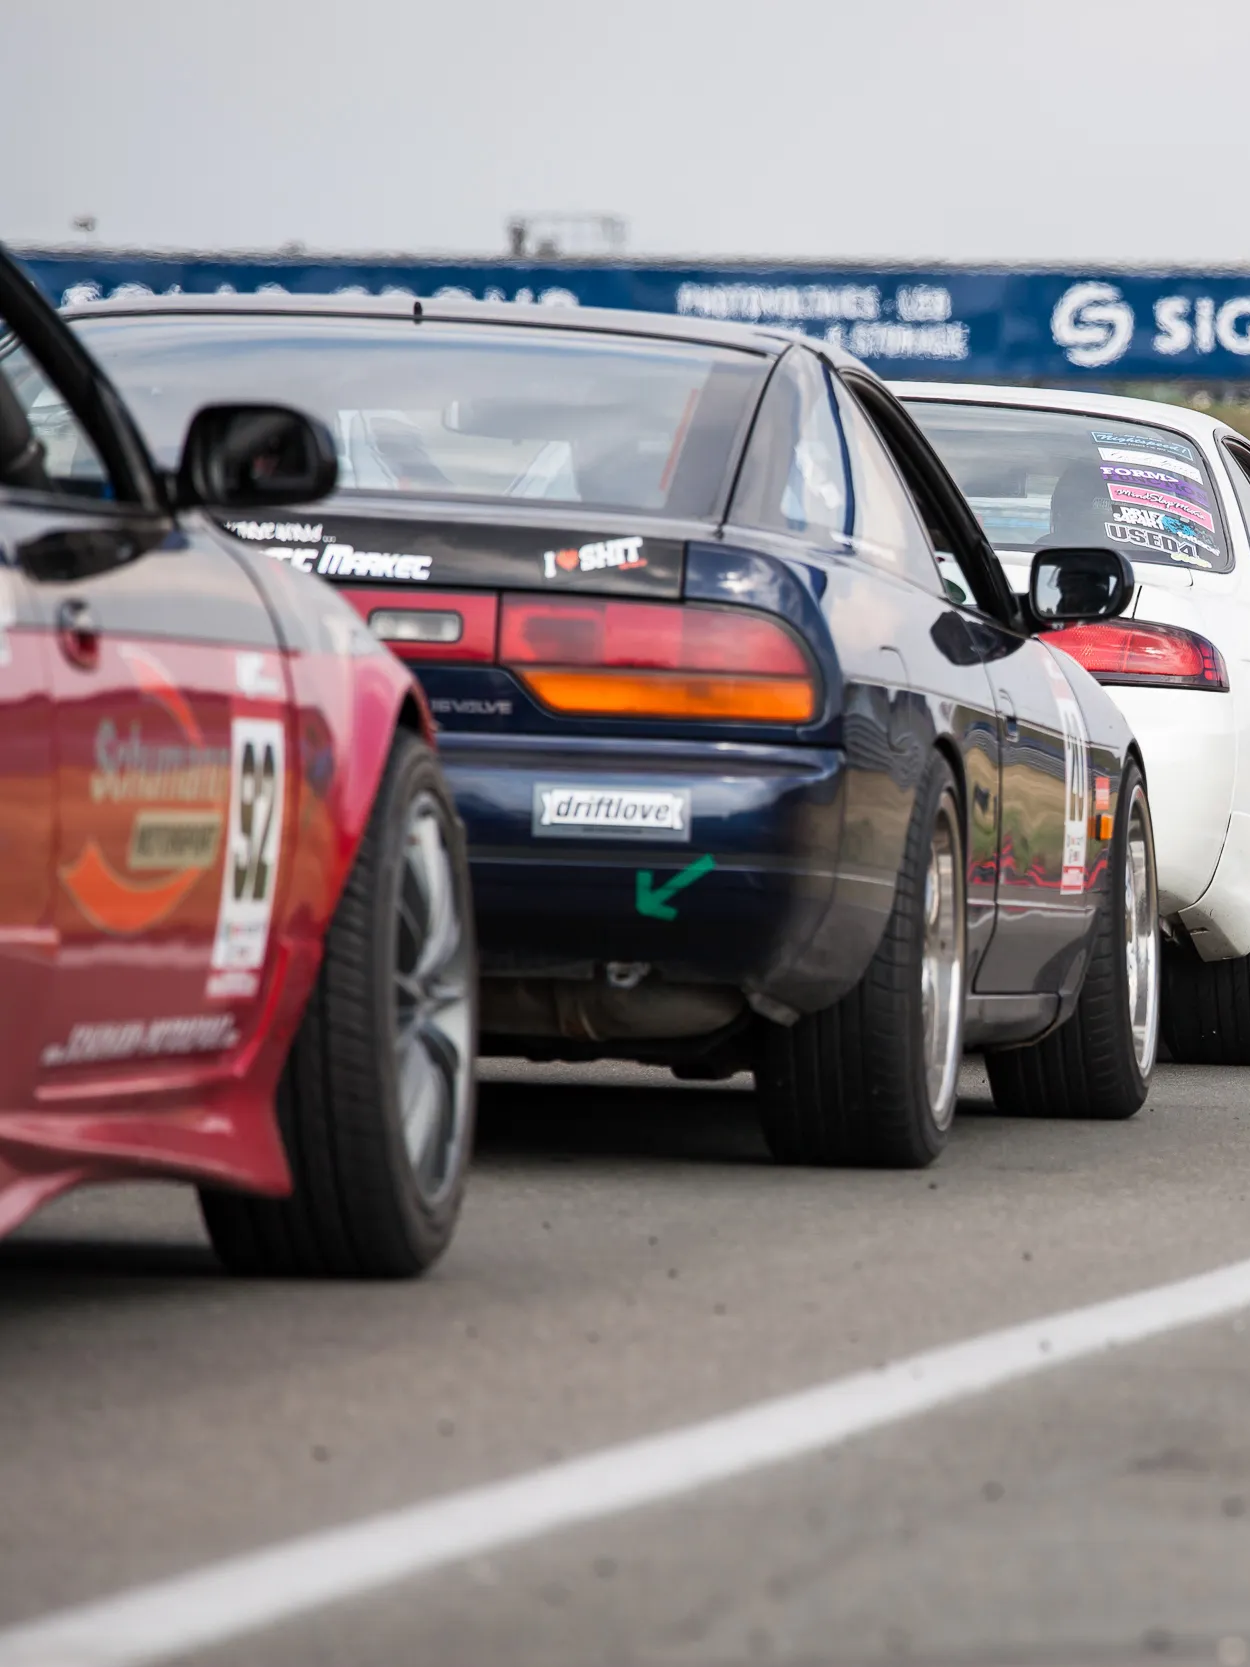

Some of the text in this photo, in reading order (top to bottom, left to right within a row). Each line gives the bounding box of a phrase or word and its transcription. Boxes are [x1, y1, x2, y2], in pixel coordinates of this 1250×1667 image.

[580, 537, 643, 572] SHIT
[233, 741, 275, 901] 92
[555, 795, 671, 822] driftlove
